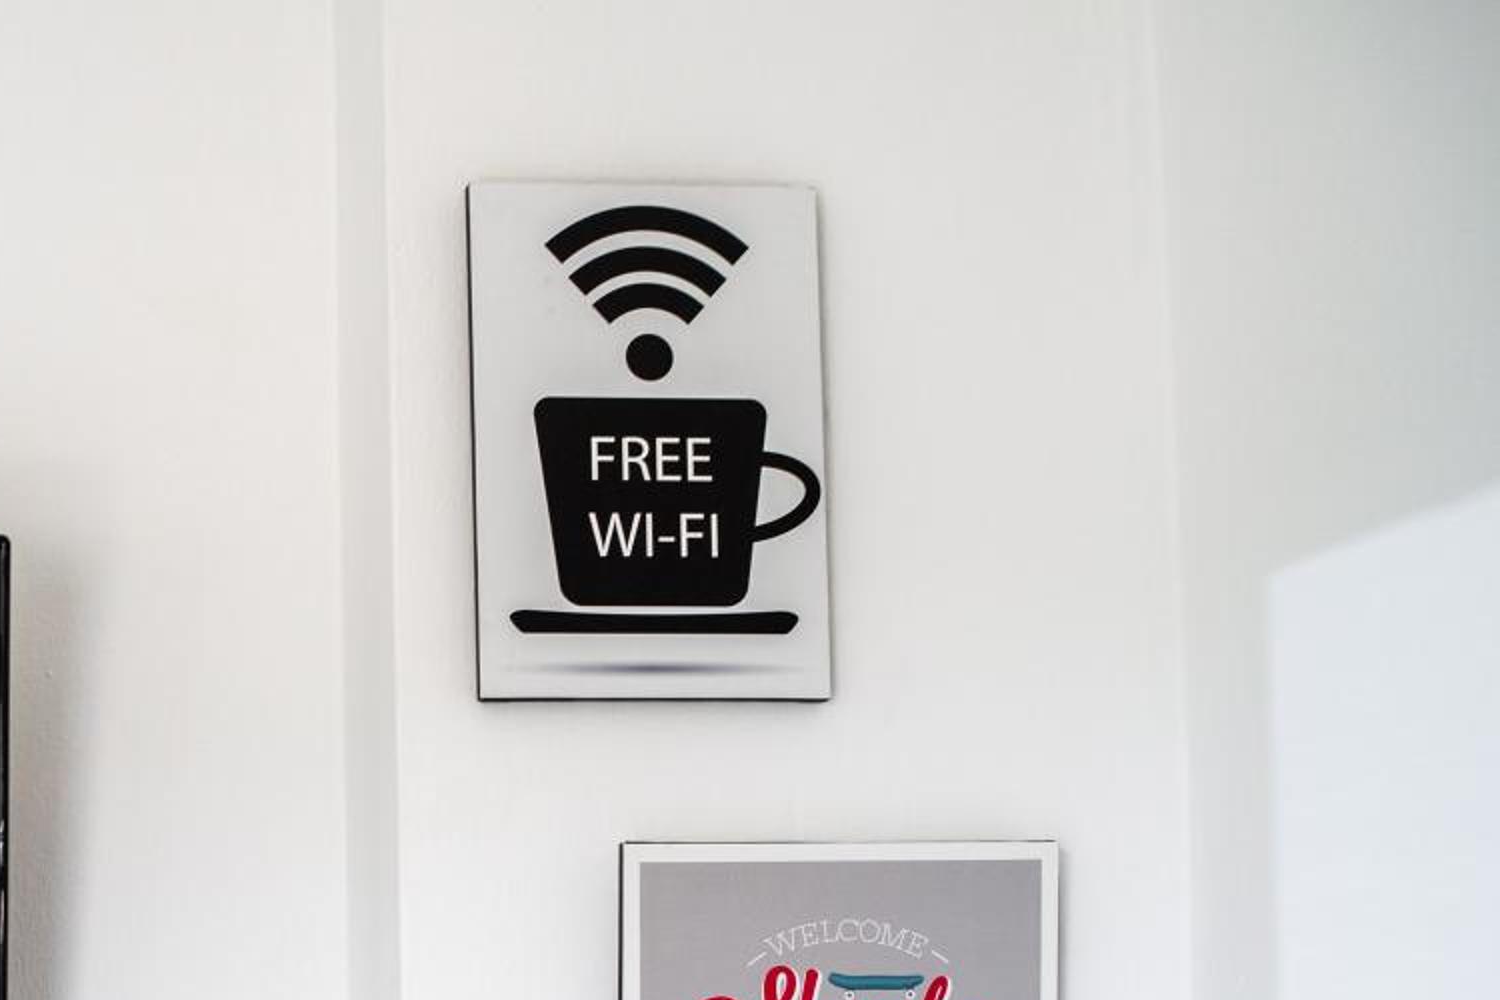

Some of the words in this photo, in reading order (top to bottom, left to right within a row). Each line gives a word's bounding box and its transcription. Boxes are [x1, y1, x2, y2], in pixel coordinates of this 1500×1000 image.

[590, 435, 713, 482] FREE
[588, 511, 719, 559] WI-FI
[763, 918, 929, 959] WELCOME
